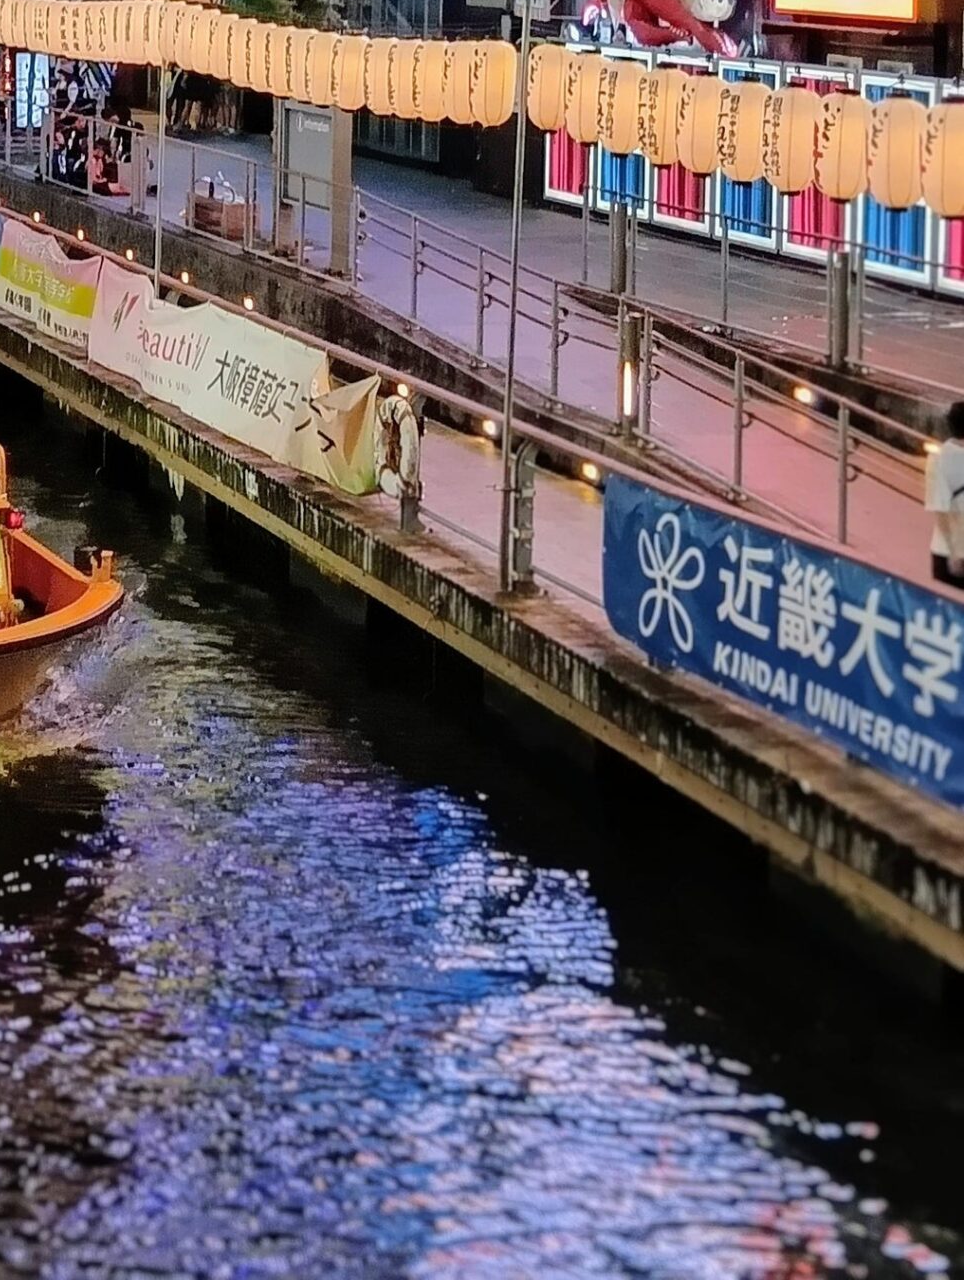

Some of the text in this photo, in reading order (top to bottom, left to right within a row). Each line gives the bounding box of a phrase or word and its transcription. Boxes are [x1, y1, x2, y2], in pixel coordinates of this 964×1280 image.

[716, 535, 964, 718] 近畿大学
[713, 641, 954, 783] KINDAI UNIVERSITY
